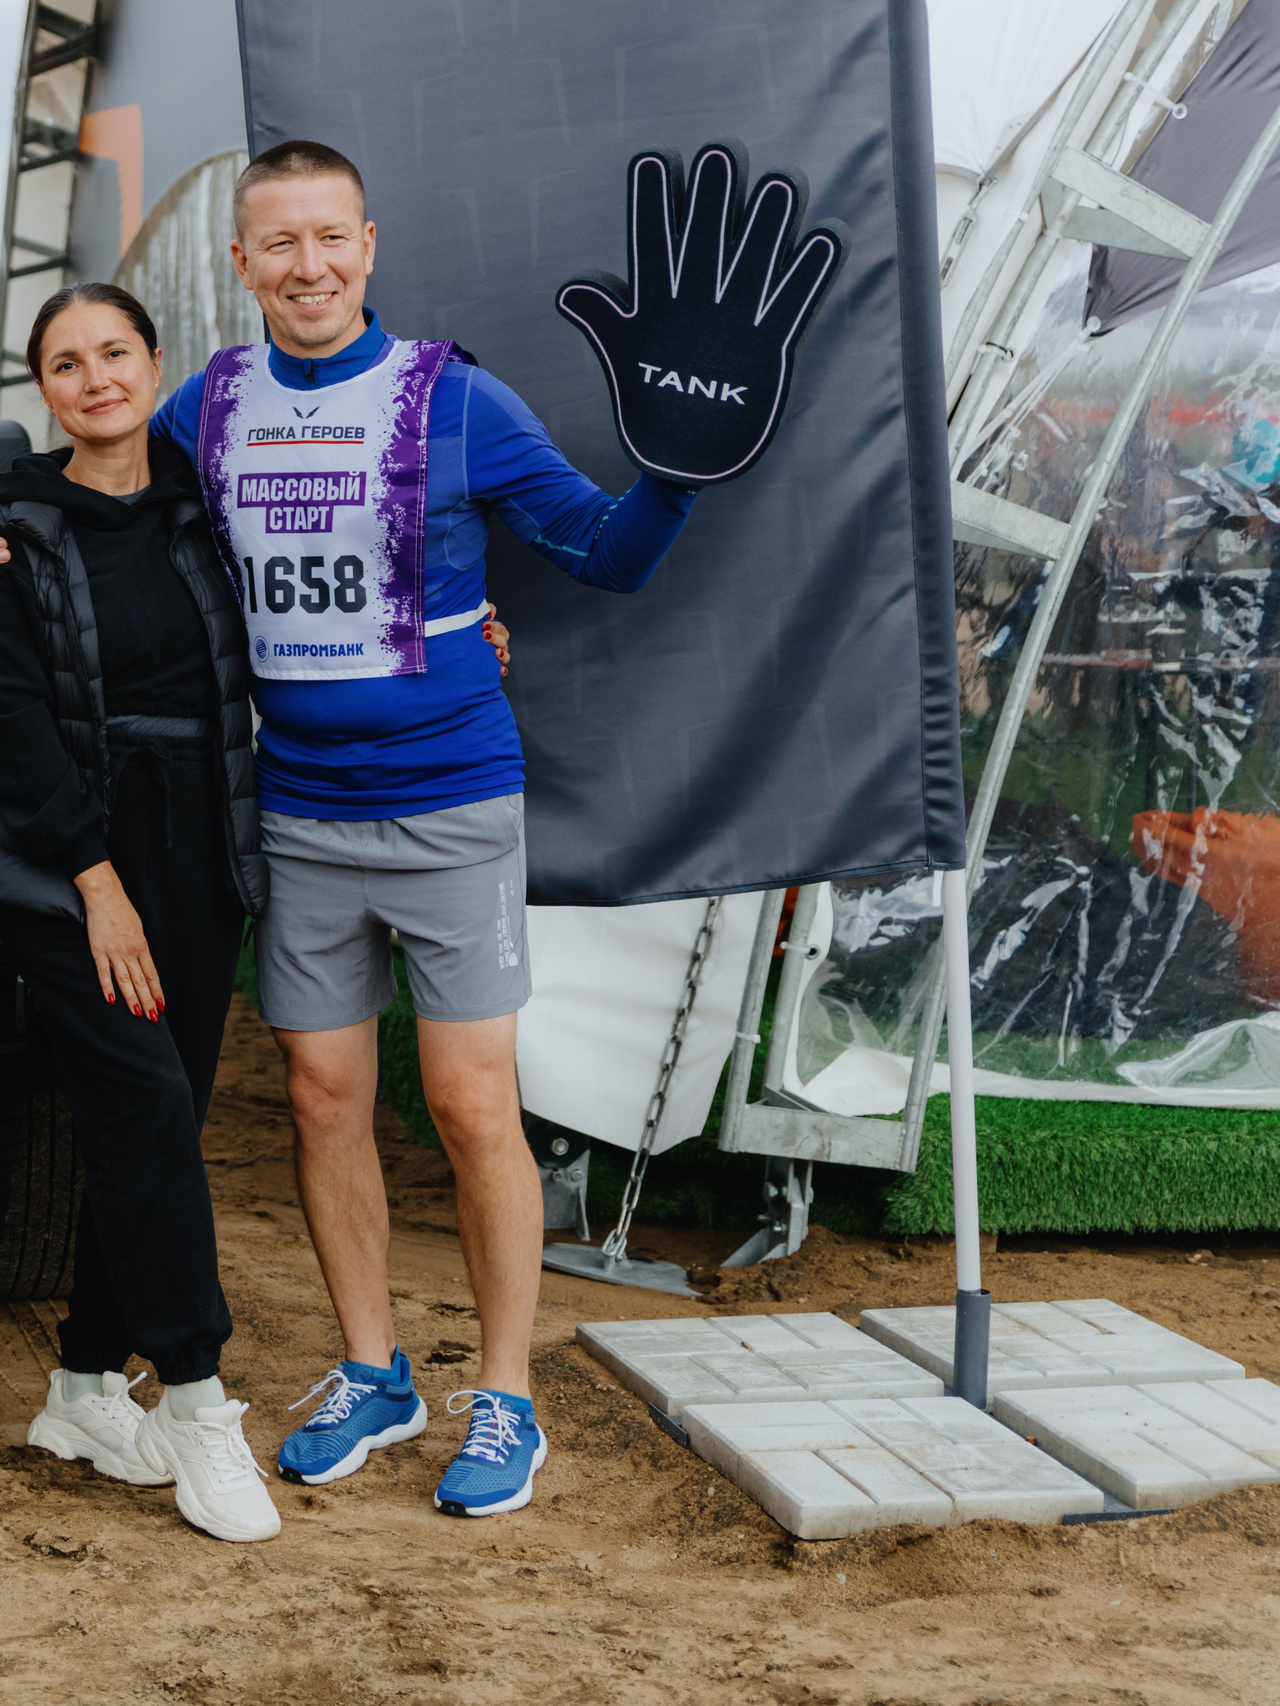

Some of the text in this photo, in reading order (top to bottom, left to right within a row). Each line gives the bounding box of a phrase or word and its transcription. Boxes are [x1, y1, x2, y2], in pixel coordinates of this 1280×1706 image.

[638, 361, 749, 406] TANK
[247, 426, 365, 442] ГОНКА ГЕРОЕВ
[242, 471, 361, 502] МАССОВЫЙ
[269, 505, 330, 531] СТАРТ
[243, 554, 367, 614] 1658
[273, 642, 364, 658] ГАЗПРОМБАНК
